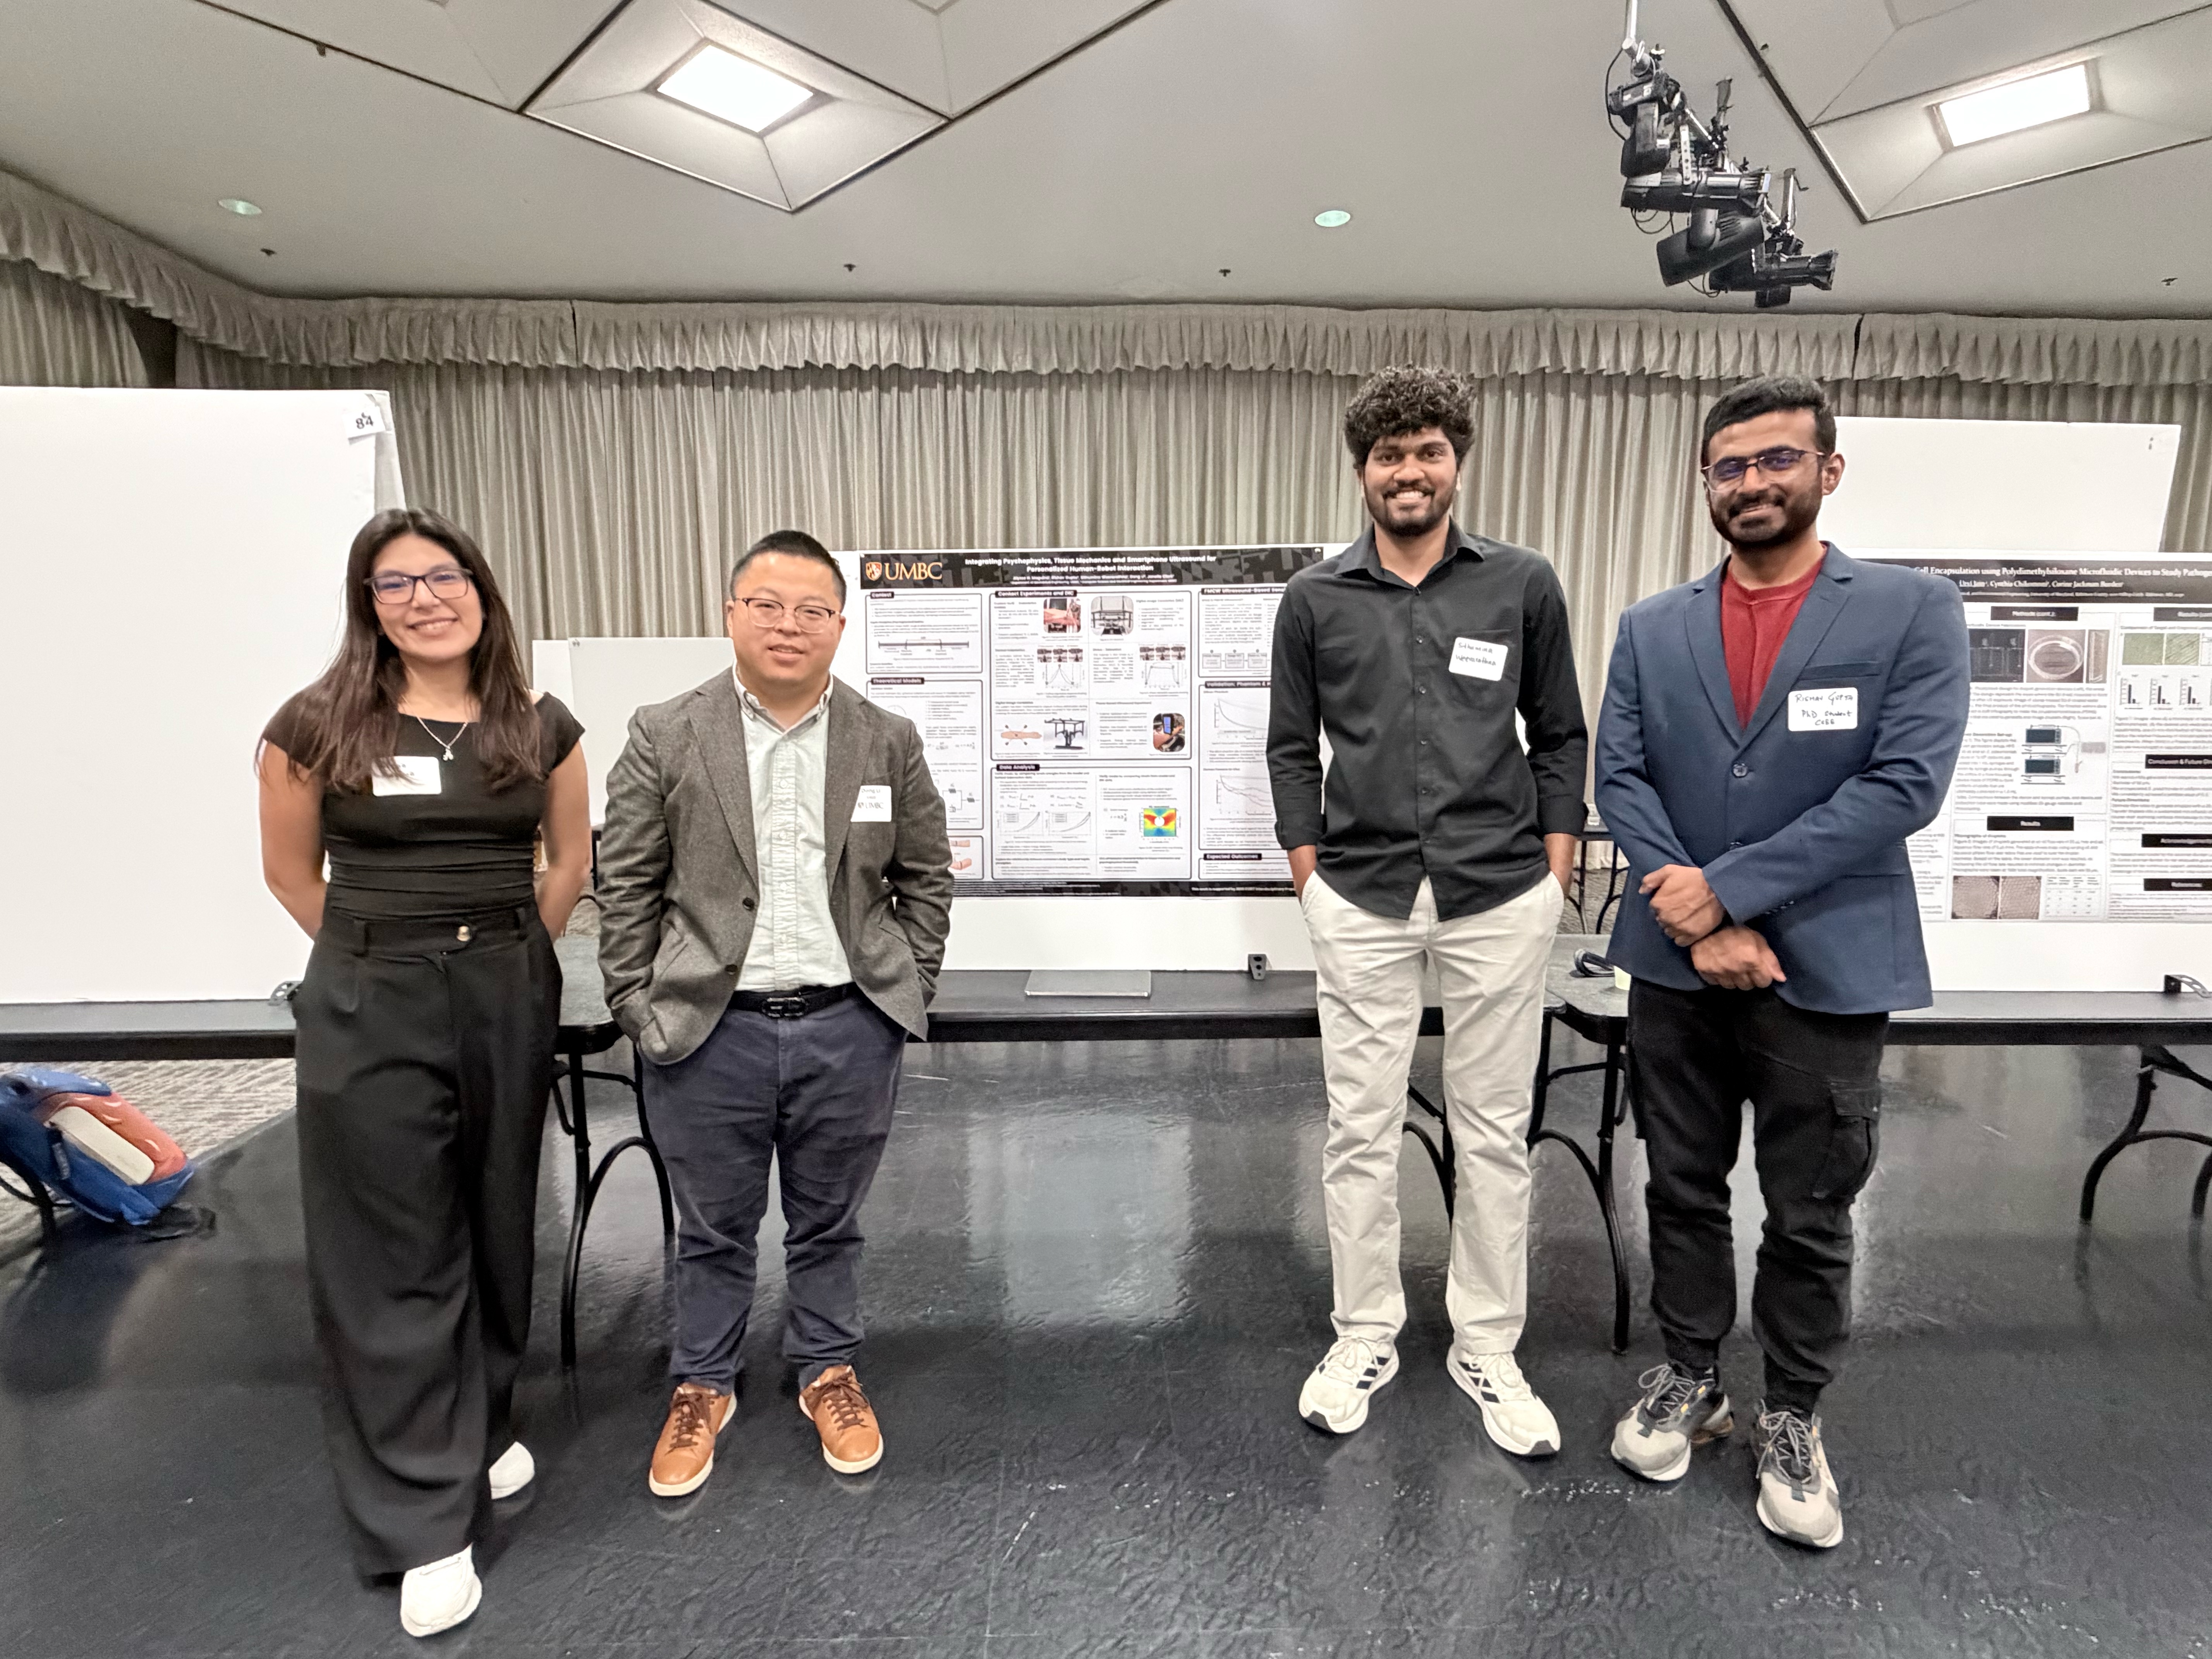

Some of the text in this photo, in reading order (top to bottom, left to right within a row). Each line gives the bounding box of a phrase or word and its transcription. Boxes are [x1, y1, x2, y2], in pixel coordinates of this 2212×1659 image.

[1003, 558, 1053, 566] Psychophysics,
[884, 562, 943, 580] UMBC
[1930, 567, 1980, 575] Encapsulation
[2161, 568, 2182, 577] Study
[1801, 709, 1818, 718] PhD
